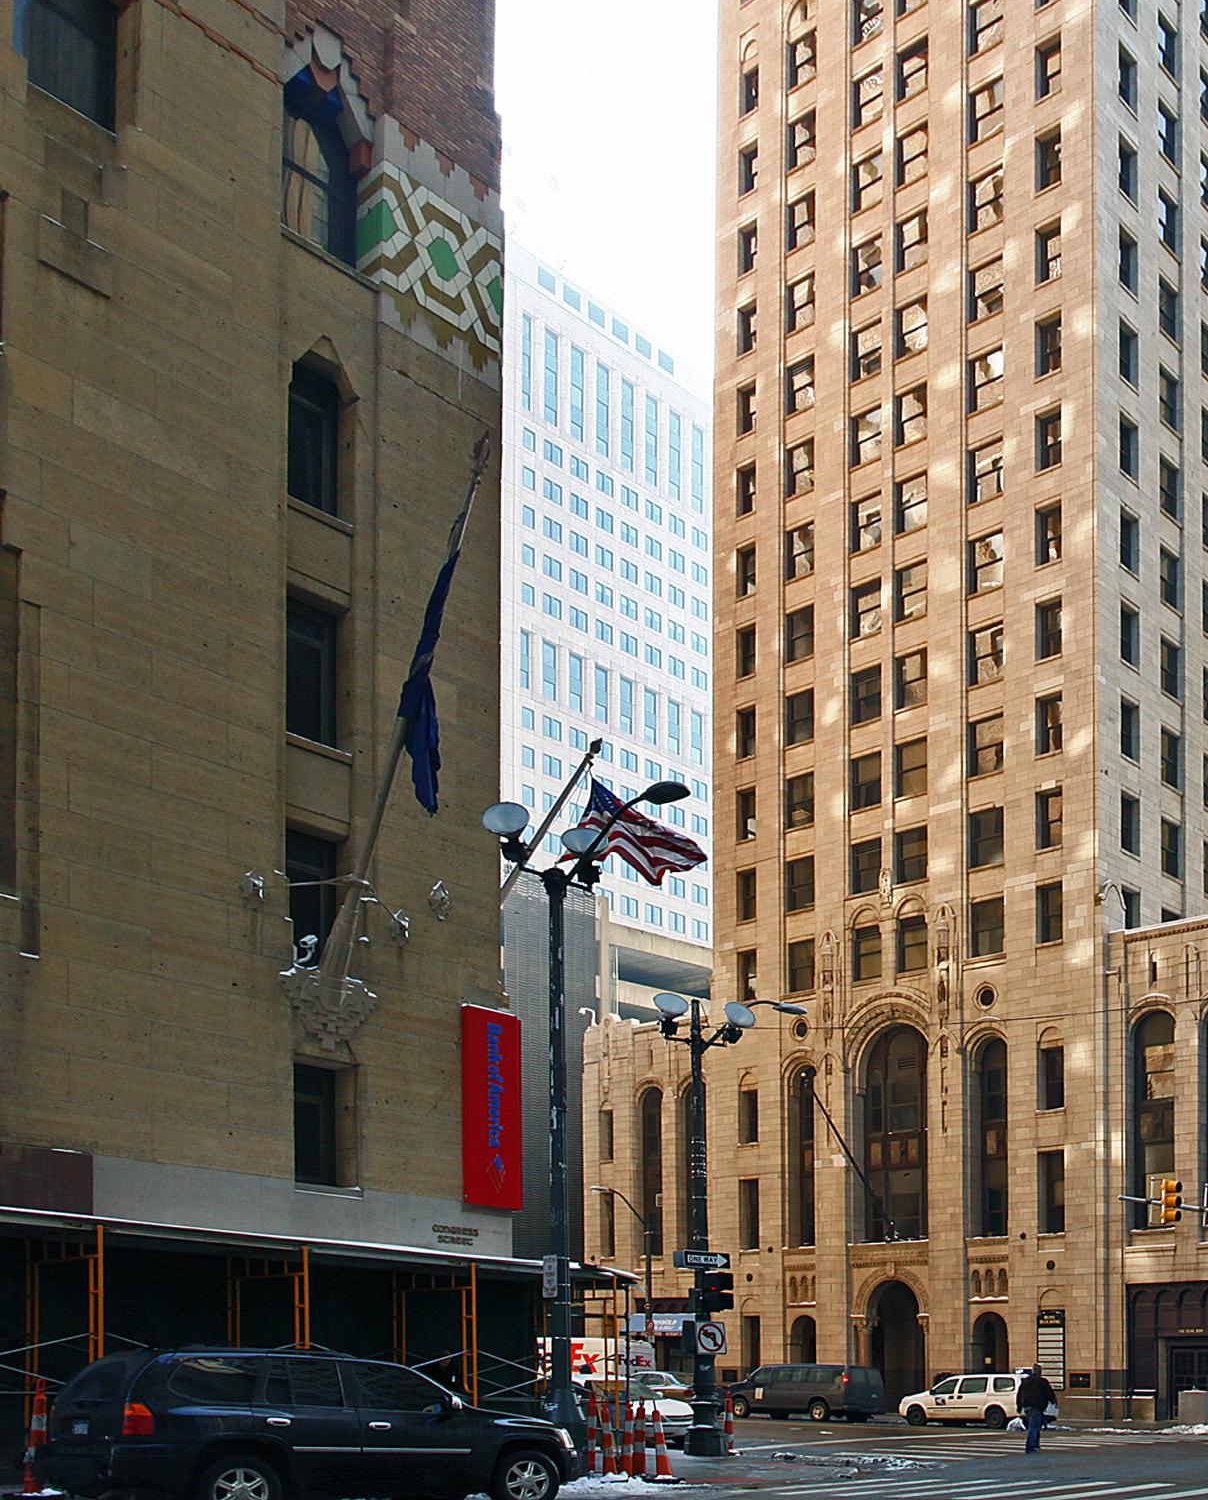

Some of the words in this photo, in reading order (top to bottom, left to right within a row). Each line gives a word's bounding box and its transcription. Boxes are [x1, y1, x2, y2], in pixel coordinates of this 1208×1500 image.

[486, 1022, 504, 1062] Bank
[487, 1063, 504, 1083] of
[487, 1082, 505, 1149] America
[689, 1255, 702, 1263] ONE
